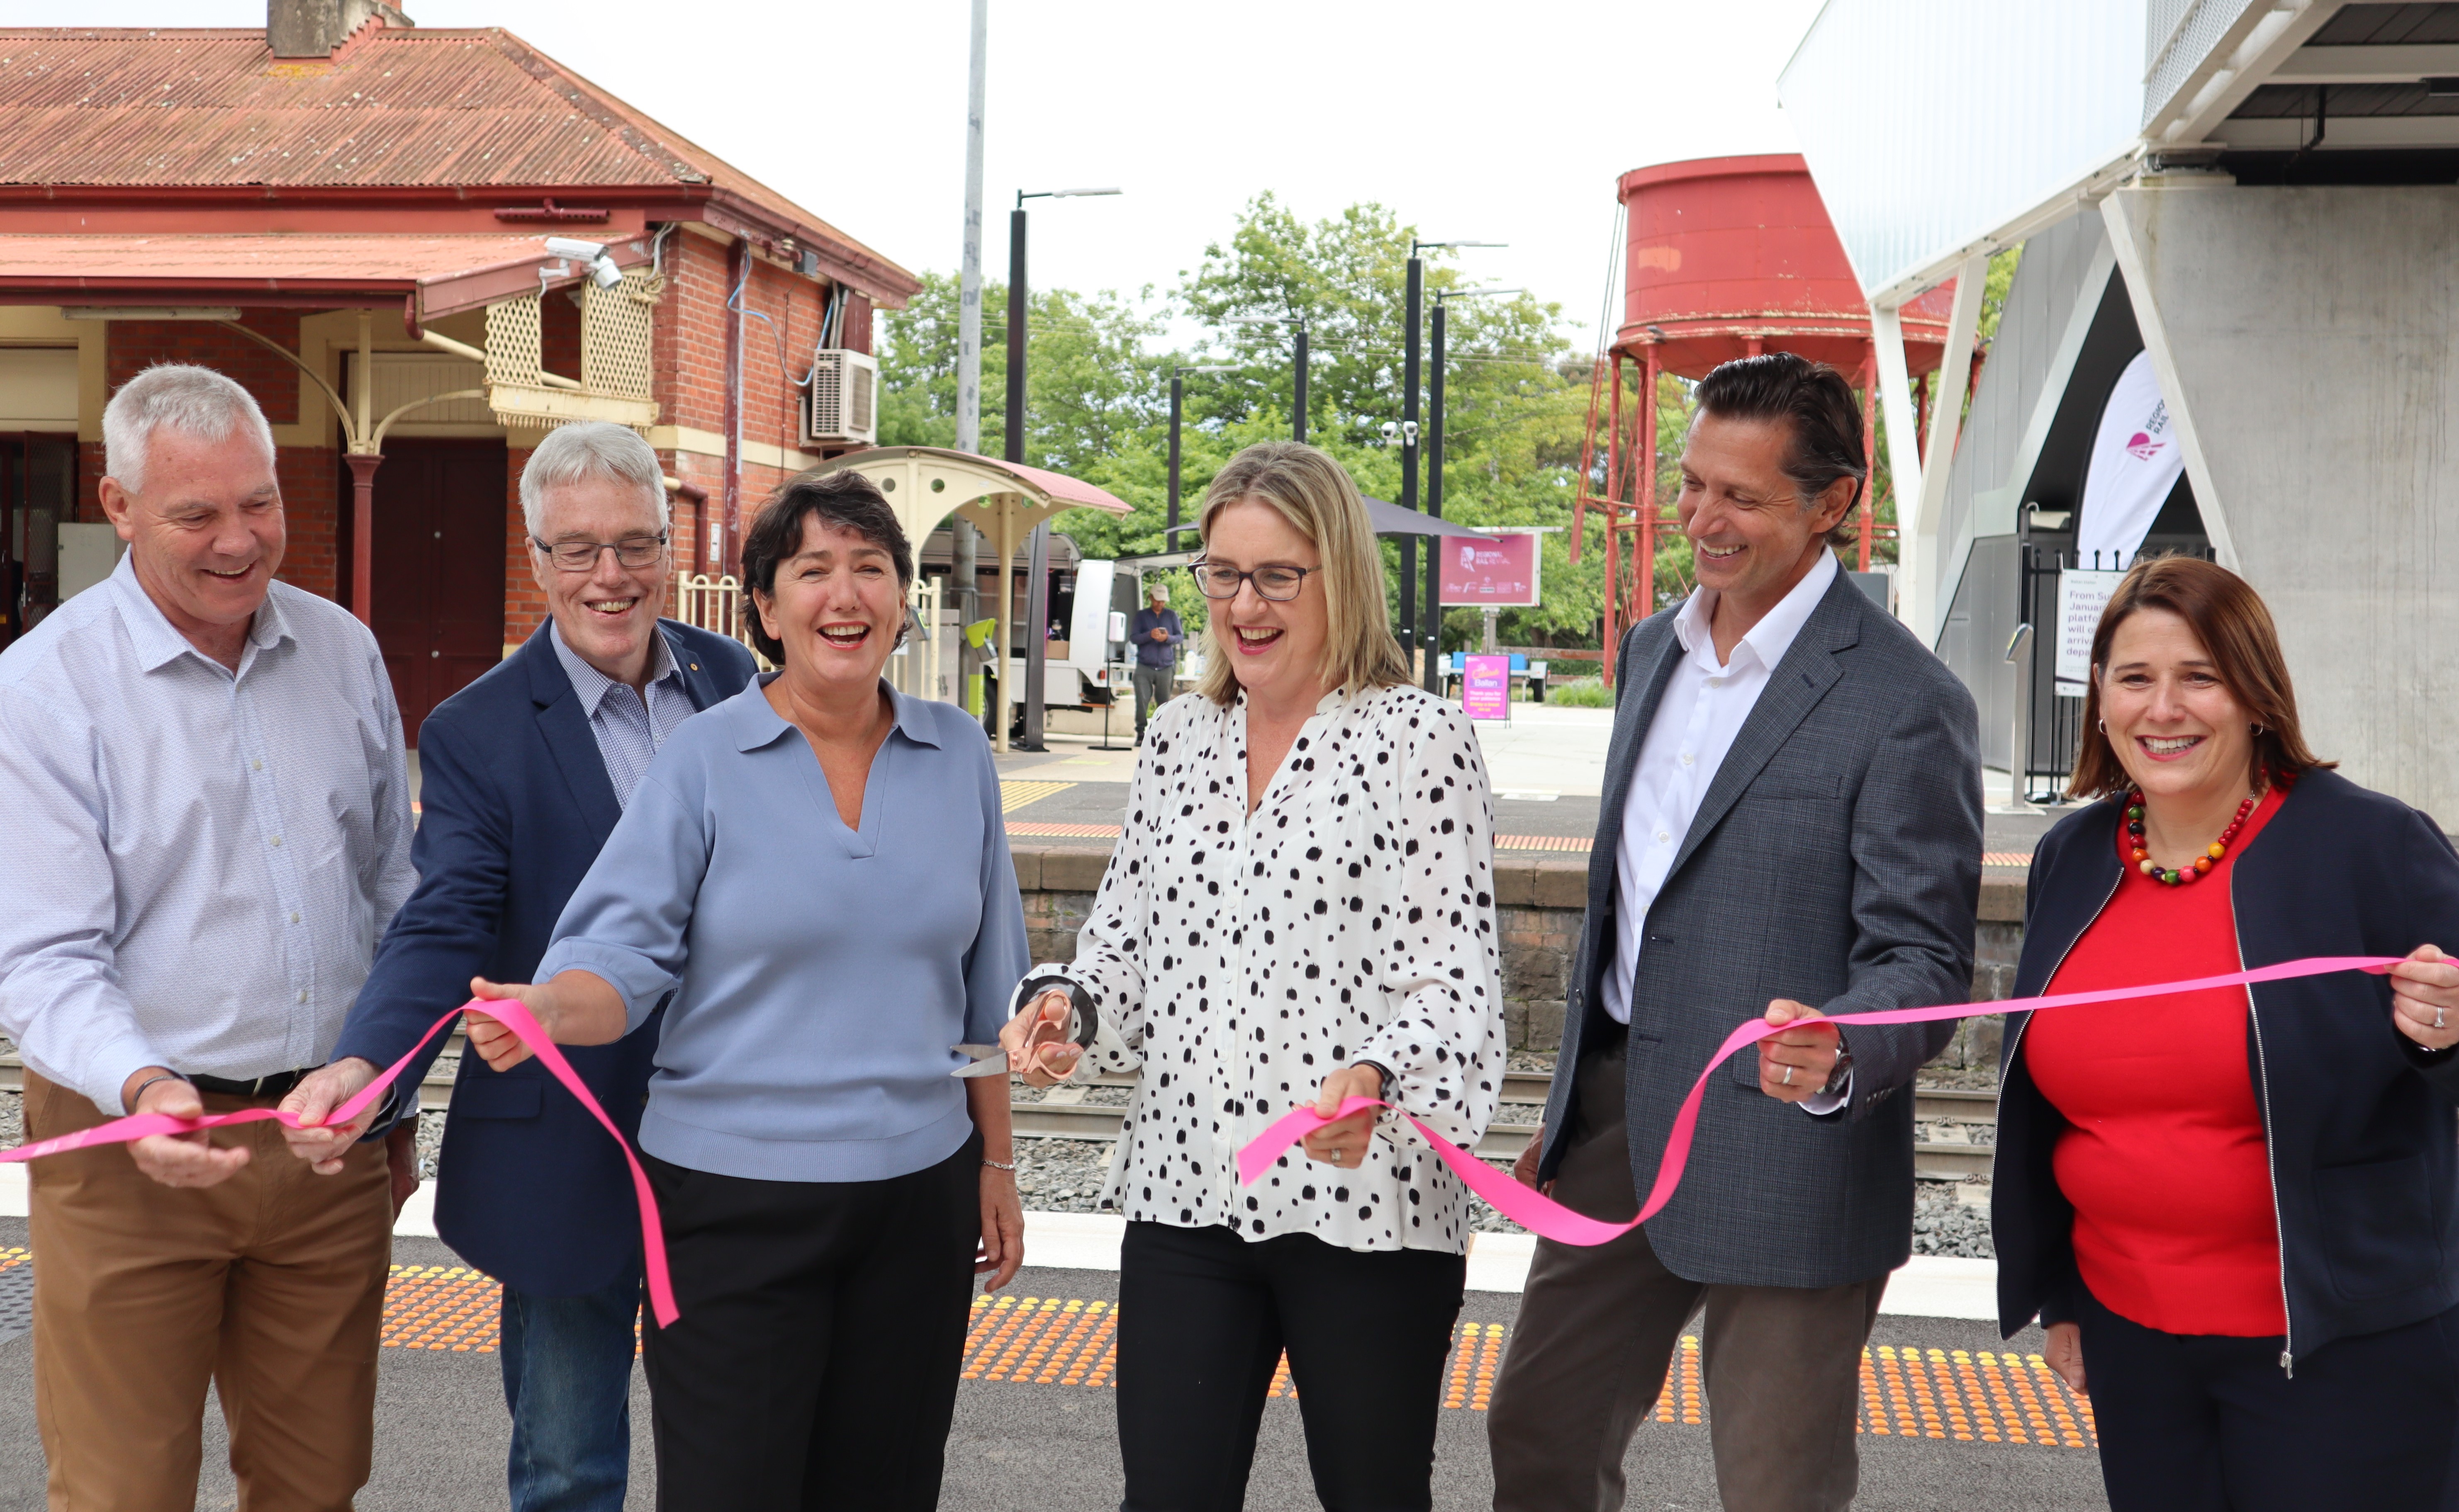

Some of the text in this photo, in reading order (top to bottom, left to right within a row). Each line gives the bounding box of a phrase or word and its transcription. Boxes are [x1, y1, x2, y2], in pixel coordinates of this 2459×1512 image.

[2153, 415, 2169, 435] RAIL
[2070, 591, 2110, 600] From Su
[2069, 603, 2102, 611] Januar
[2068, 613, 2099, 624] platfo
[2068, 625, 2084, 633] will
[2067, 647, 2090, 658] depa
